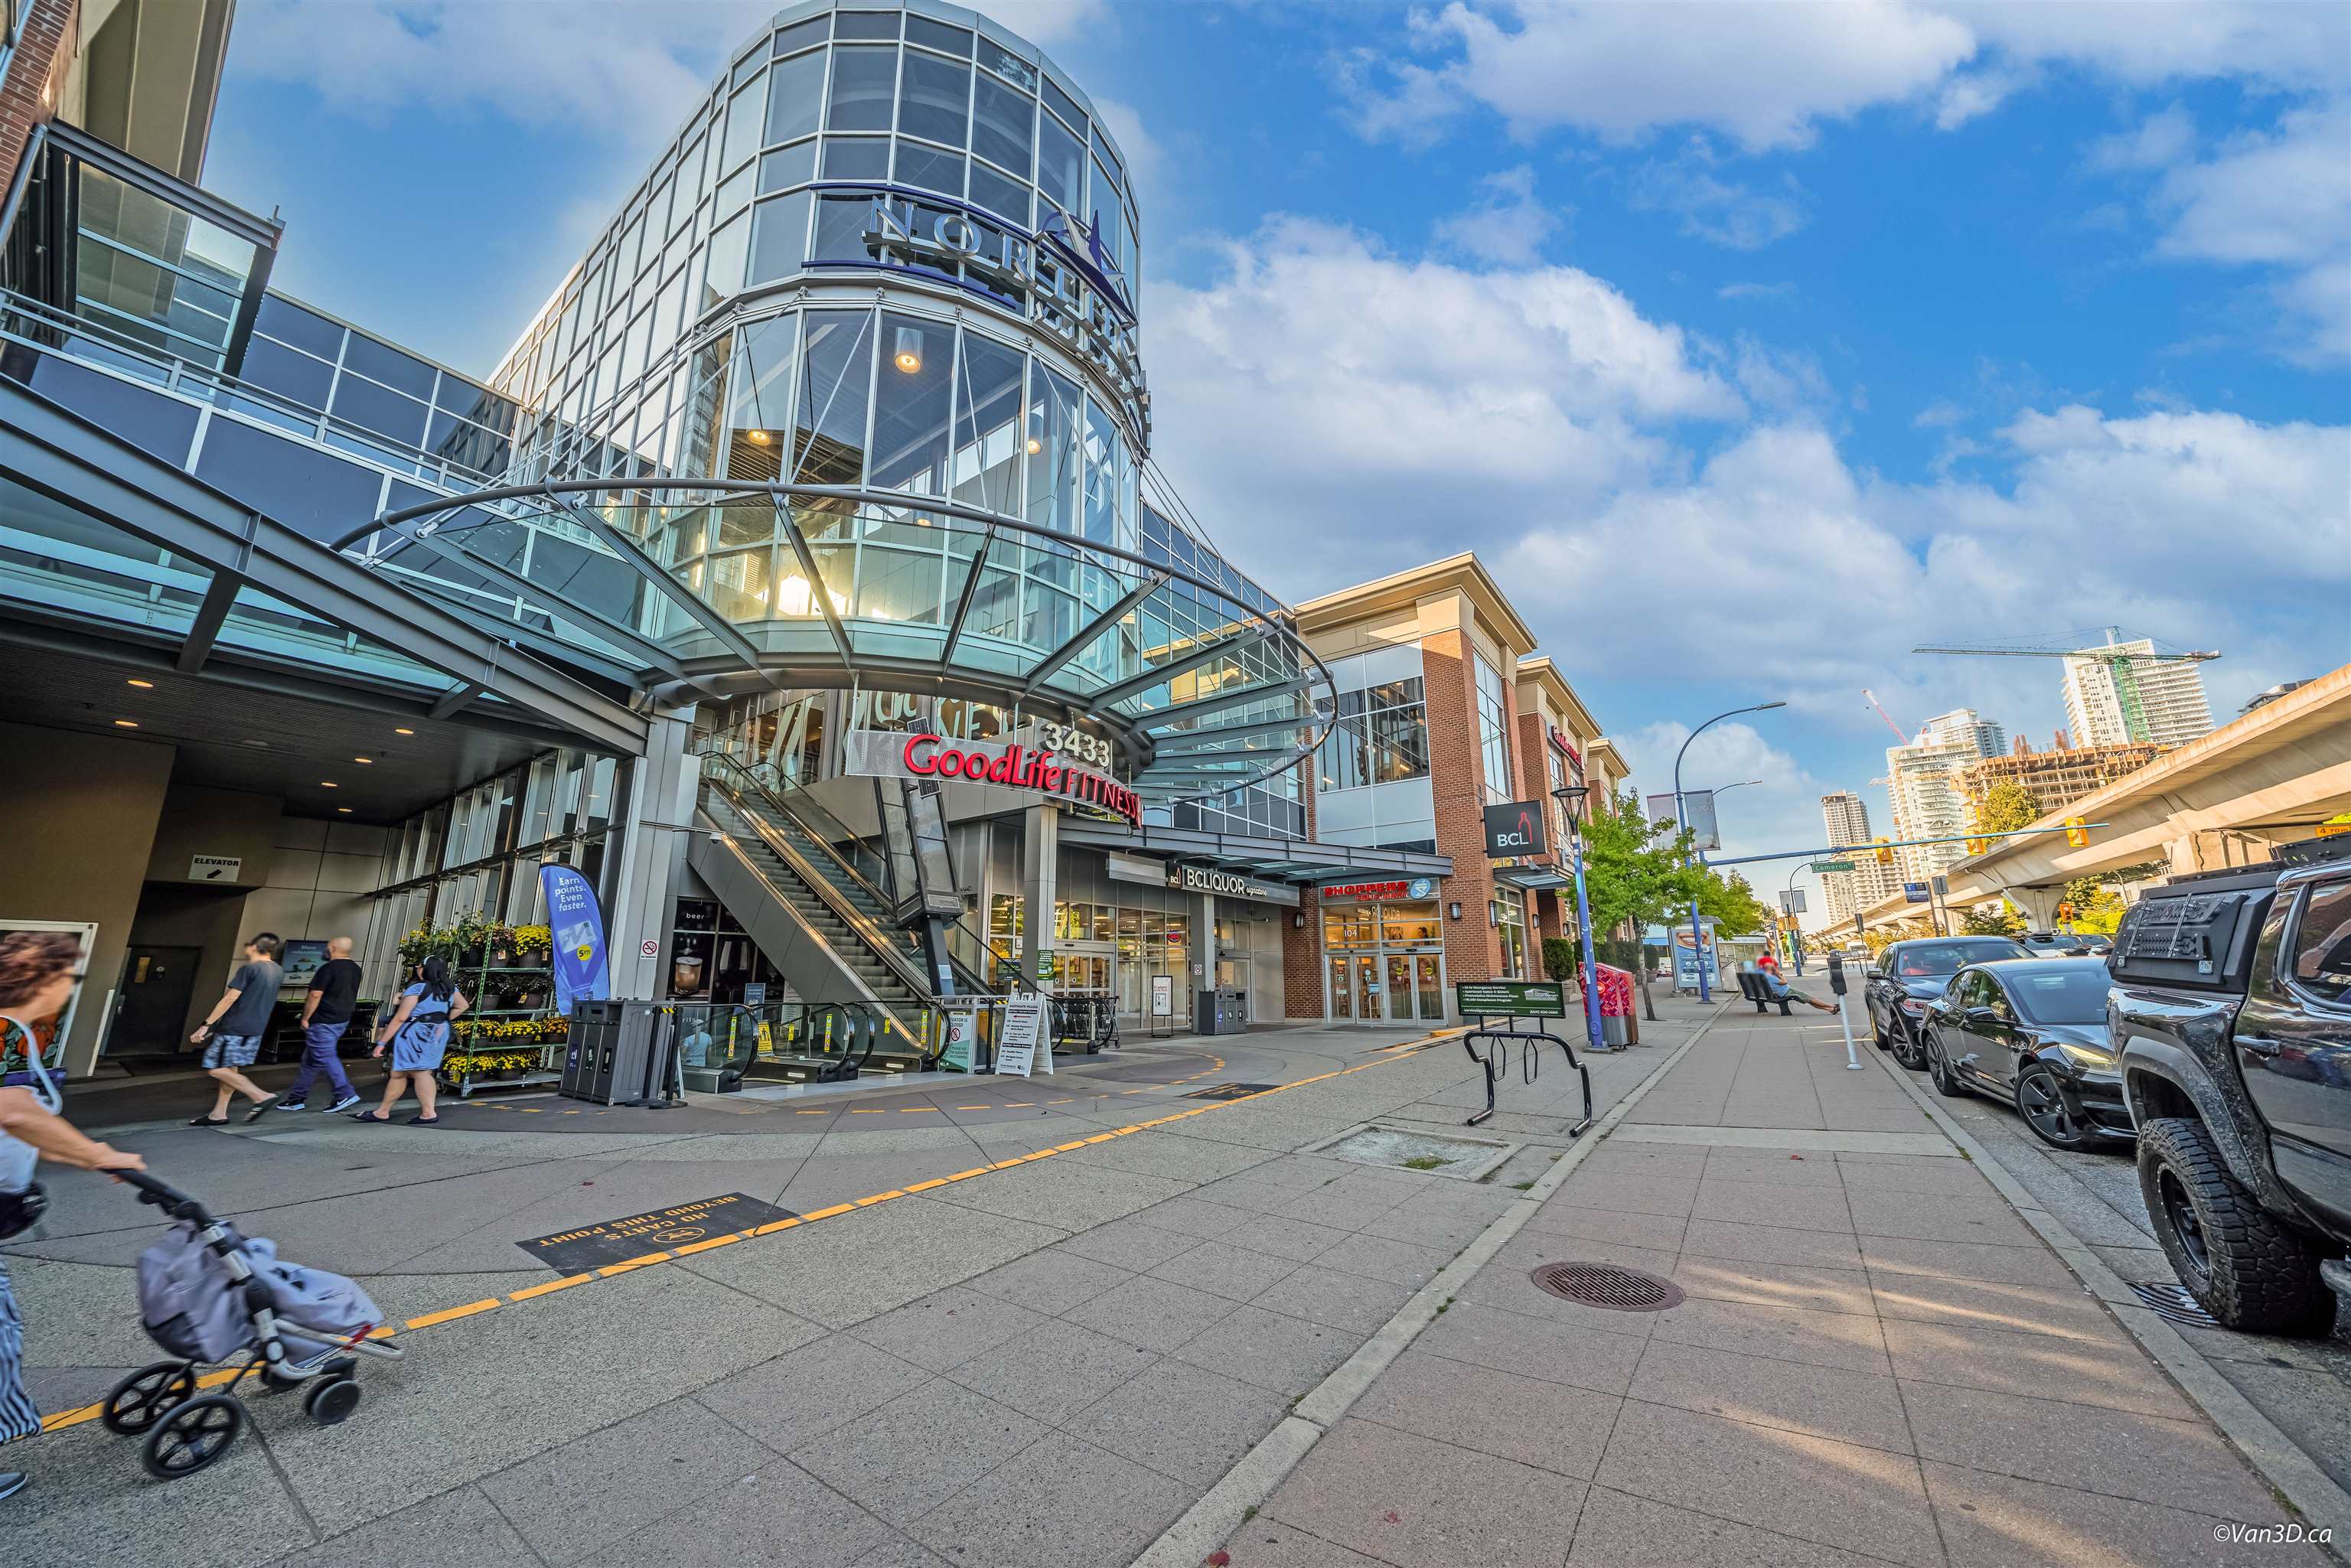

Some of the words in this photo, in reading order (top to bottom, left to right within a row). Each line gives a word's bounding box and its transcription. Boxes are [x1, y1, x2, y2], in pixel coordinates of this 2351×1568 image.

[1042, 723, 1110, 768] 3433
[904, 733, 1062, 792] GoodLife
[1061, 768, 1136, 820] FITNESS
[1497, 832, 1529, 847] BCL
[194, 858, 240, 867] ELEVATOR
[559, 877, 580, 886] Earn
[554, 885, 587, 897] points.
[1246, 885, 1268, 897] signature
[1324, 881, 1409, 898] SHOPPERS
[560, 894, 582, 903] Even
[559, 901, 588, 912] faster.
[1344, 929, 1358, 937] 104
[664, 1195, 739, 1216] BEYOND
[610, 1214, 662, 1229] THIS
[680, 1212, 709, 1222] NO
[539, 1227, 607, 1247] POINT
[604, 1220, 677, 1241] CARTS
